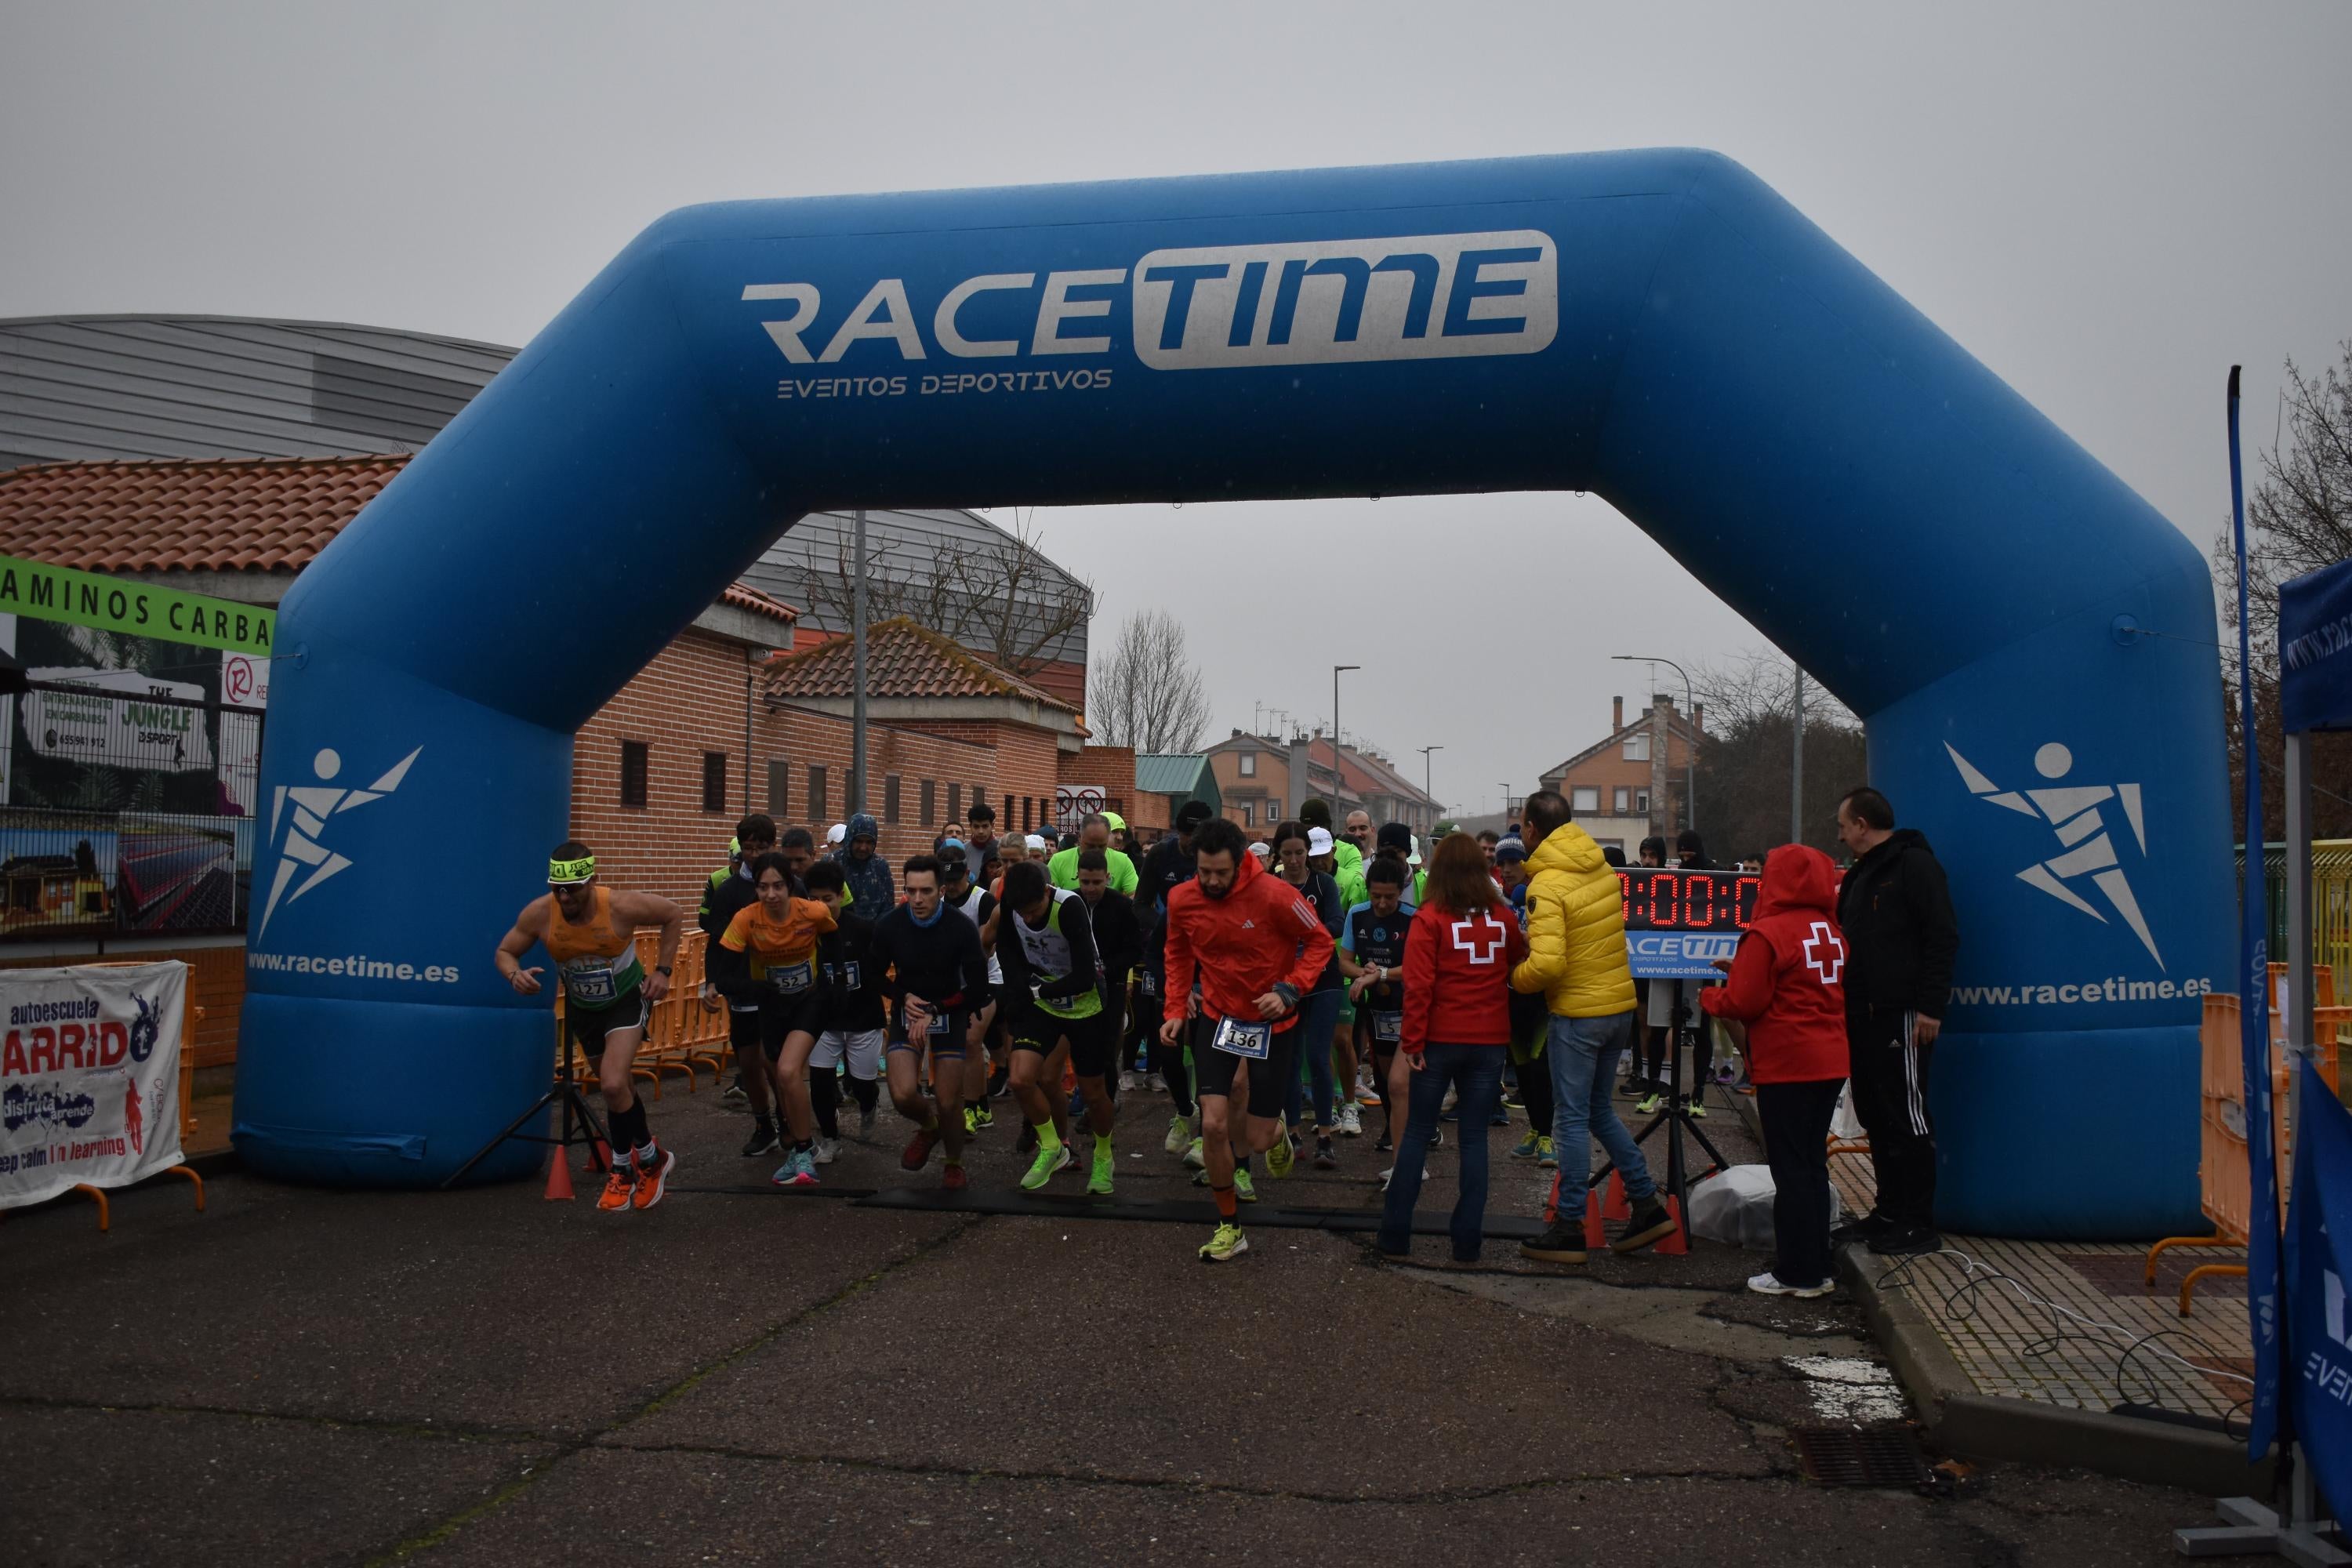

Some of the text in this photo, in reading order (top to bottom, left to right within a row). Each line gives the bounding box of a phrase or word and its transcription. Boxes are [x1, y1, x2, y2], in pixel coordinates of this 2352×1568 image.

[777, 369, 1112, 398] EVENTOS DEPORTIVOS
[169, 602, 269, 647] CARBA
[122, 703, 192, 731] JUNGLE
[249, 952, 459, 983] www.racetime.es
[575, 983, 602, 996] 127
[782, 977, 798, 988] 52
[1947, 977, 2212, 1005] ww.racetime.es
[11, 996, 100, 1025] autoescuela
[1227, 1029, 1257, 1048] 136
[4, 1096, 94, 1120] disfruta aprende
[21, 1148, 47, 1169] calm
[70, 1137, 125, 1160] learning
